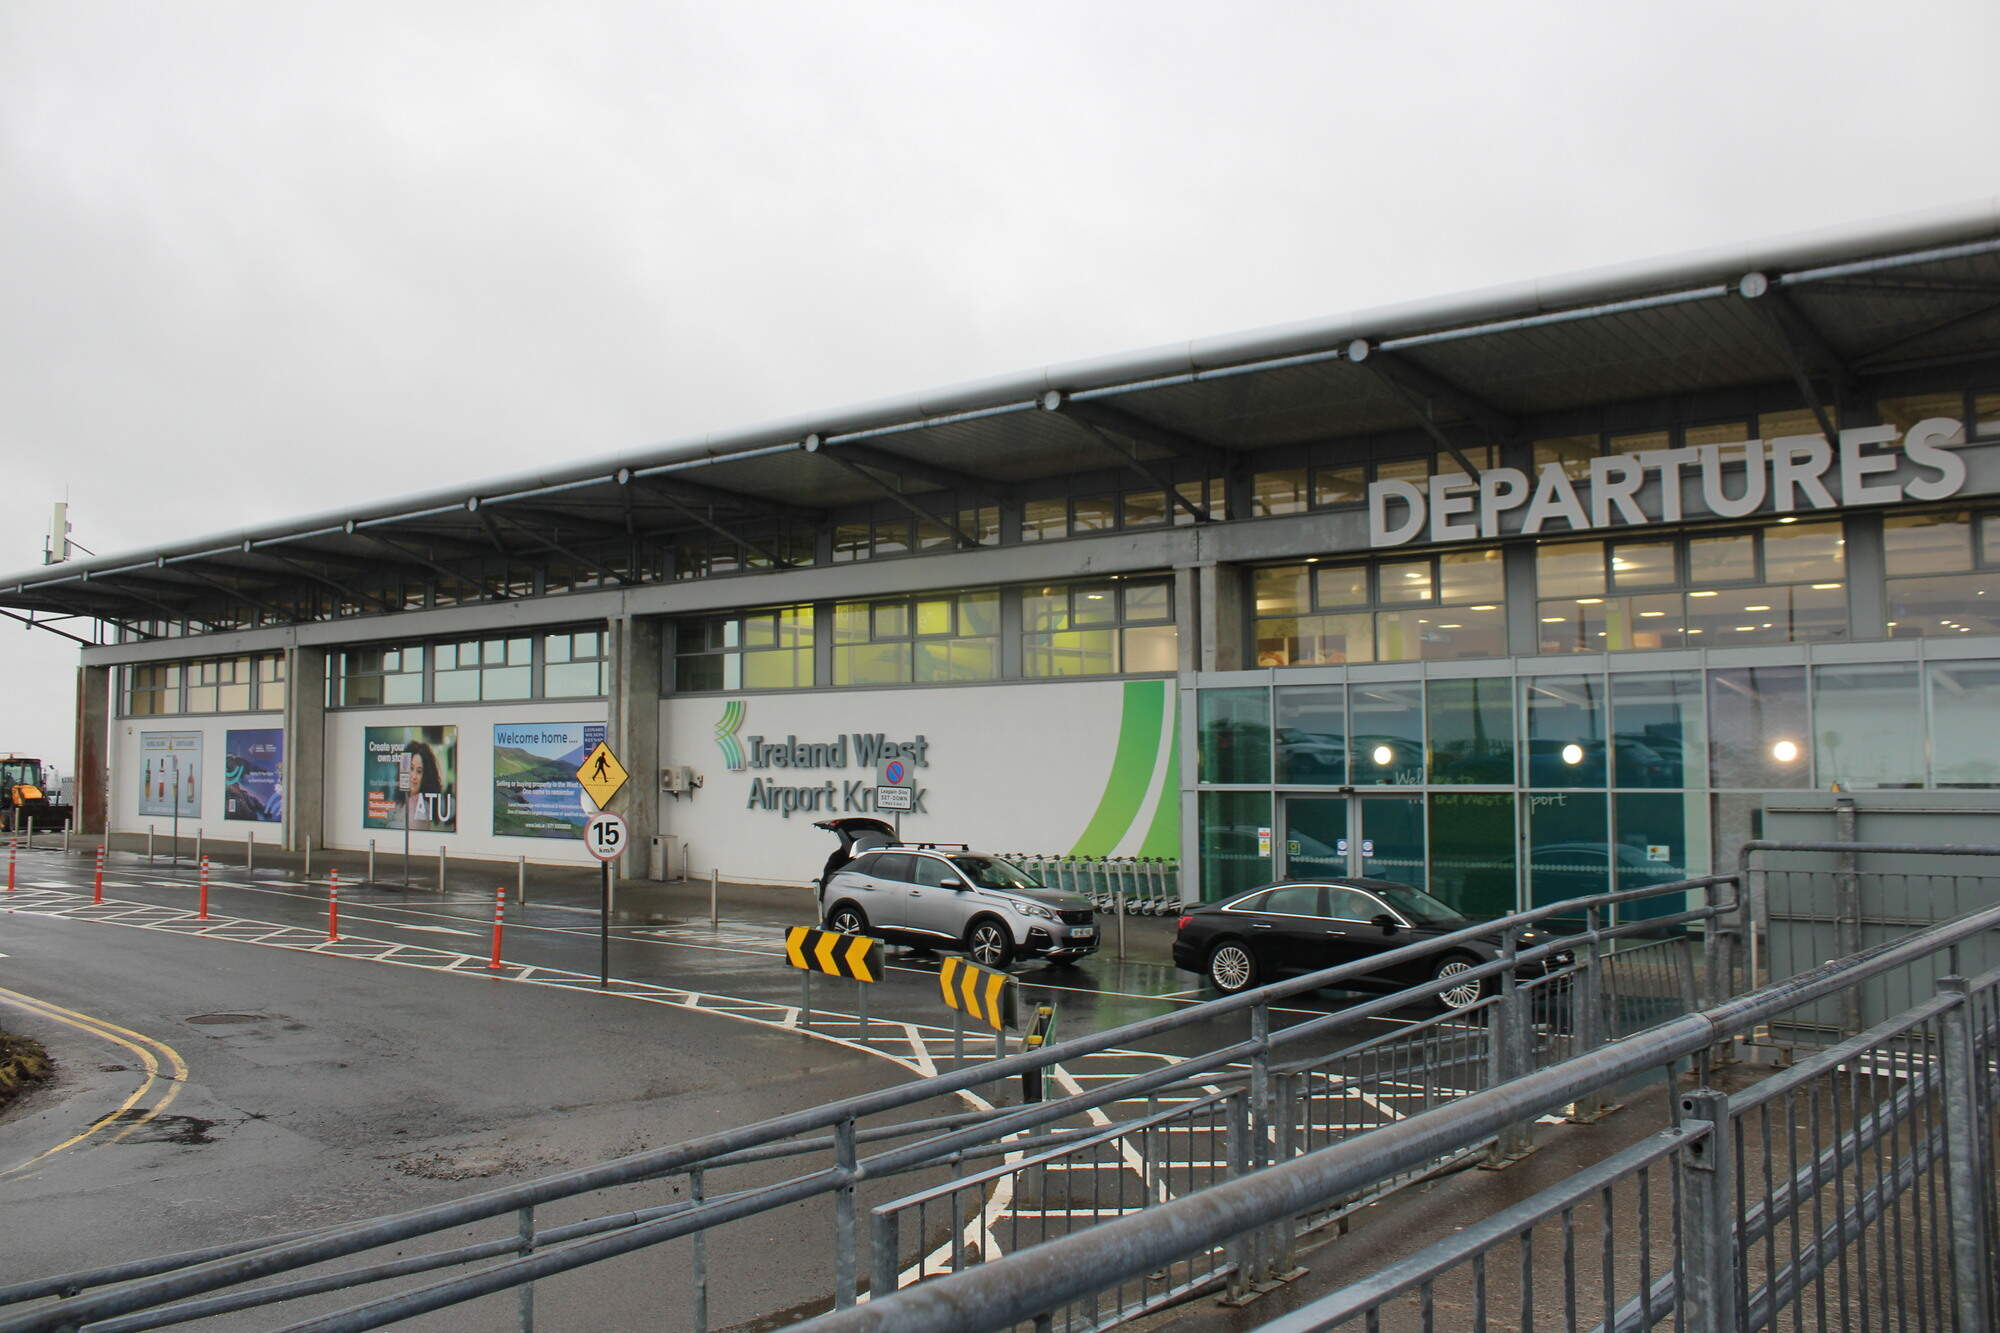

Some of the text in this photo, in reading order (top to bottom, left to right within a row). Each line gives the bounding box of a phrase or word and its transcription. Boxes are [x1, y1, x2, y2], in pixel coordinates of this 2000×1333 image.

[1368, 416, 1967, 548] DEPARTURES
[369, 741, 406, 754] Create your
[497, 732, 539, 744] Welcome
[747, 733, 929, 768] Ireland West
[377, 754, 391, 762] own
[414, 792, 451, 822] ATU
[746, 777, 928, 818] Airport Knk
[593, 821, 620, 846] 15
[598, 845, 616, 853] km/h
